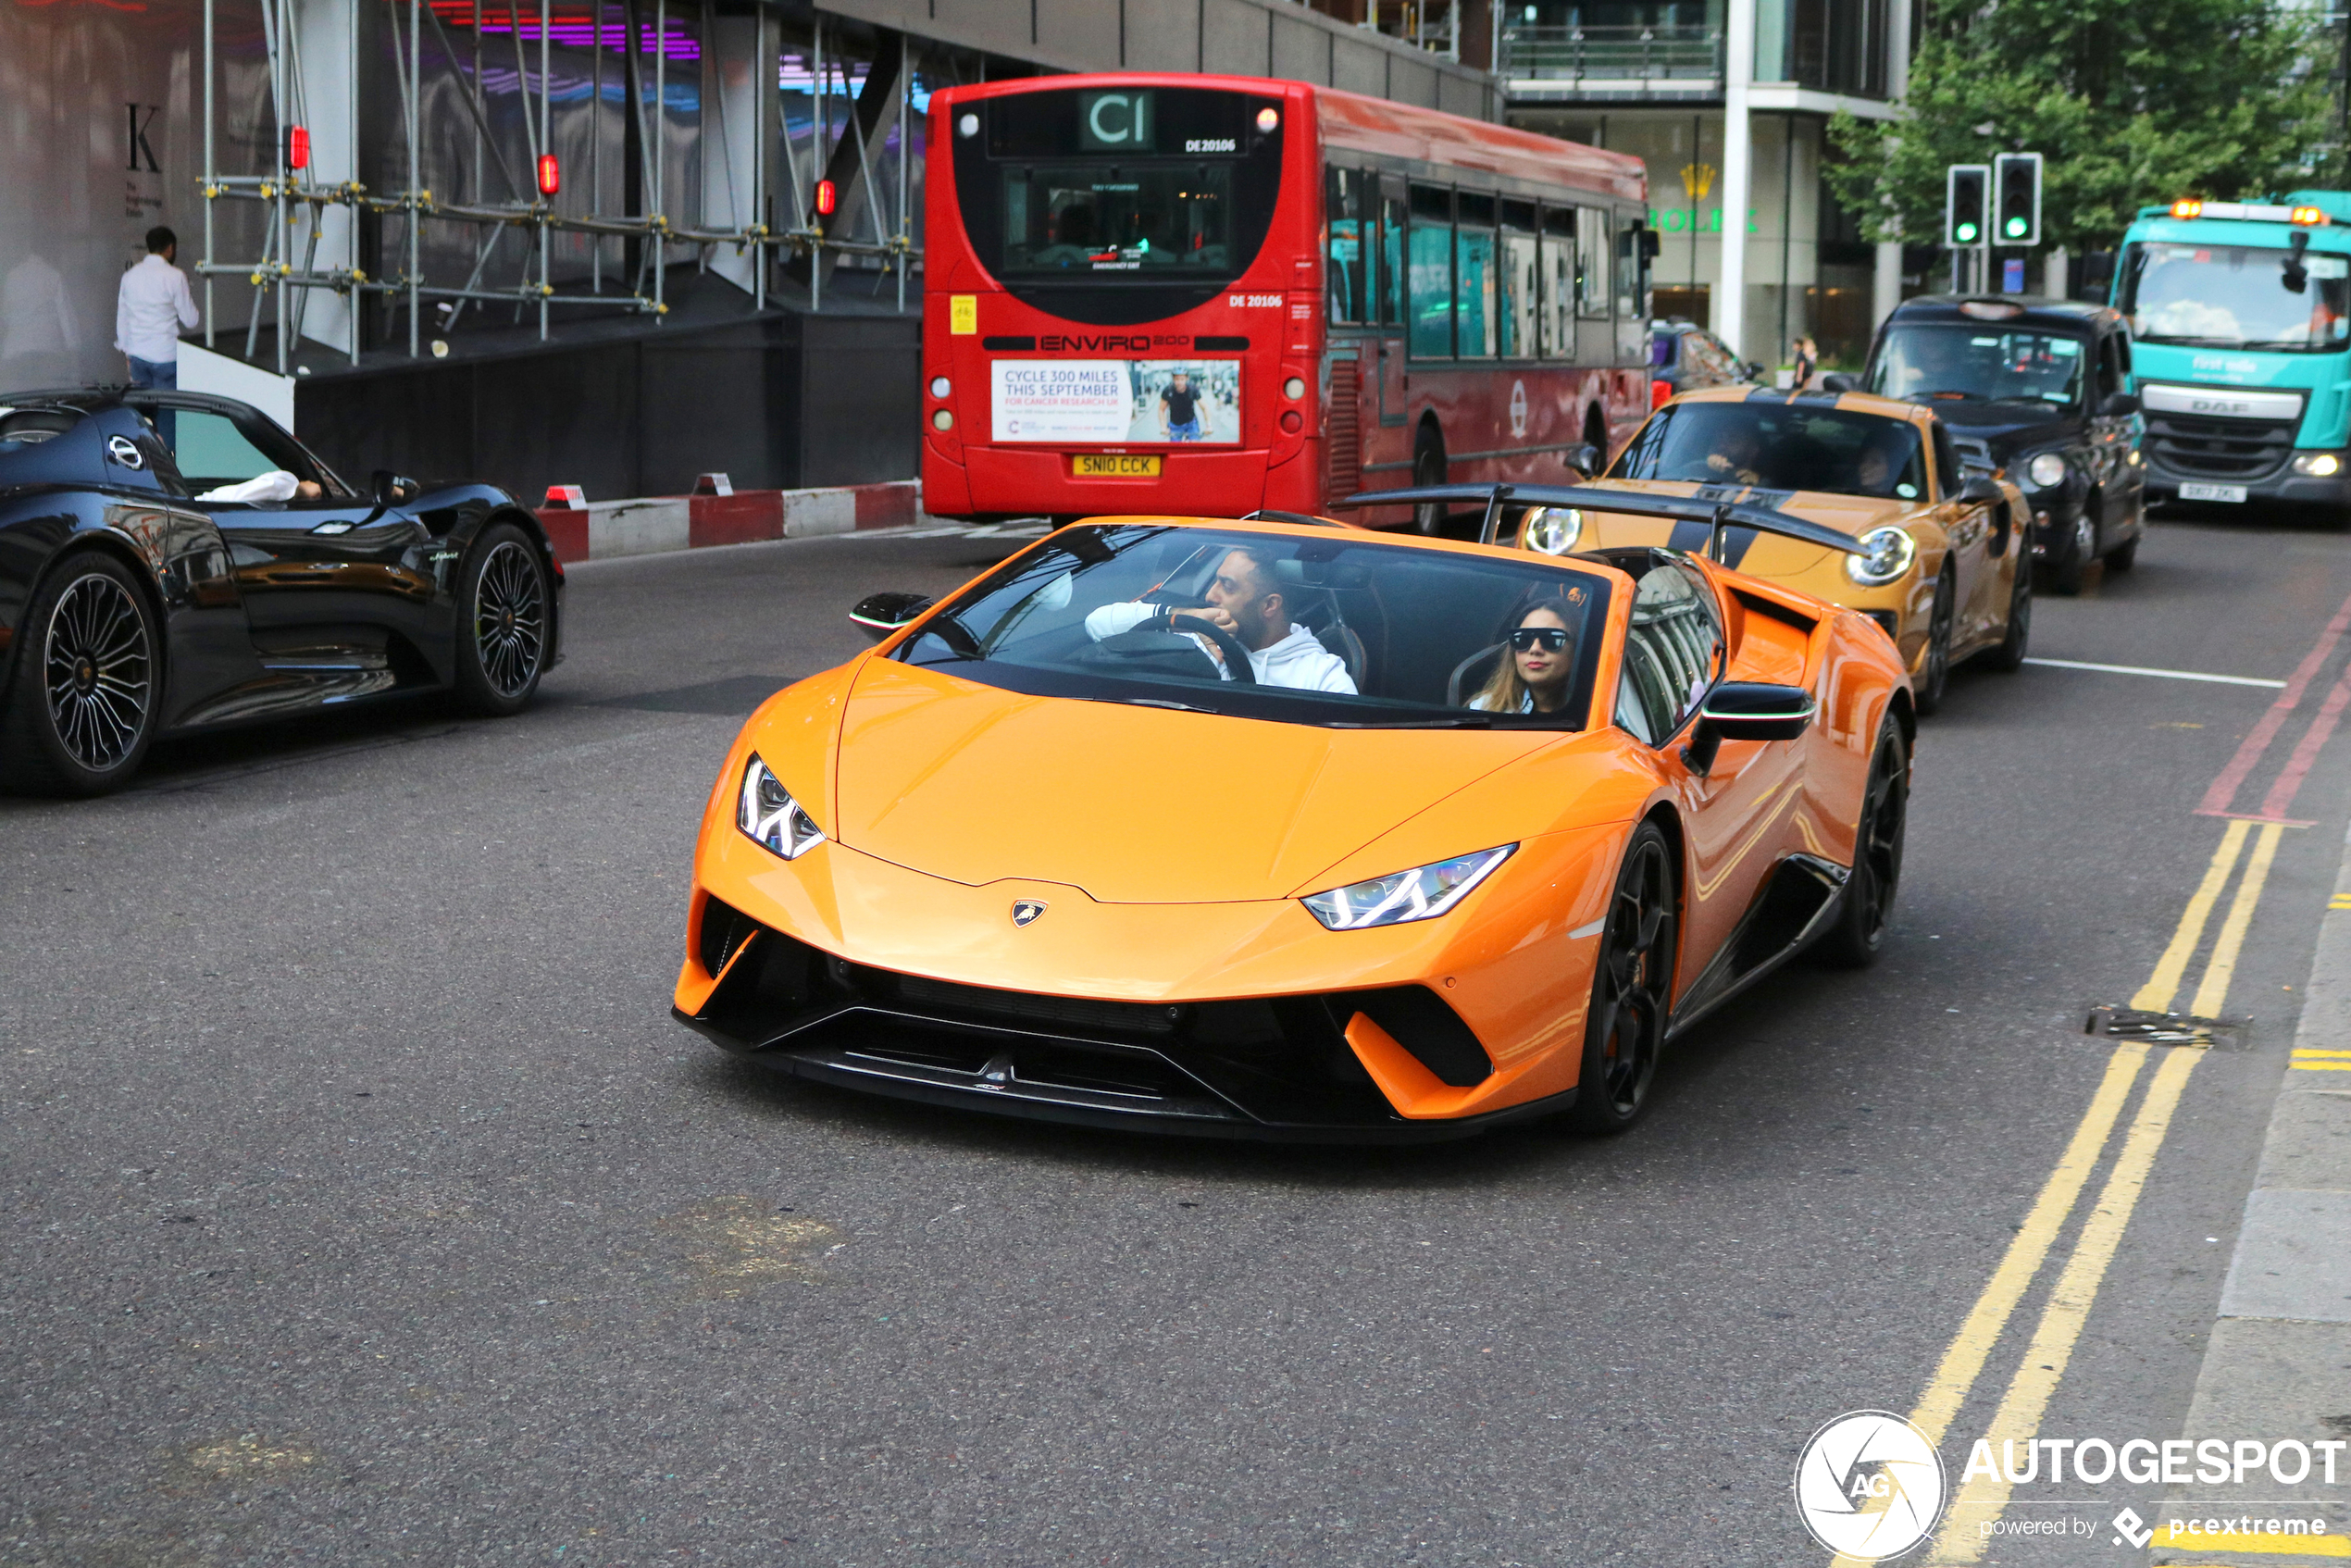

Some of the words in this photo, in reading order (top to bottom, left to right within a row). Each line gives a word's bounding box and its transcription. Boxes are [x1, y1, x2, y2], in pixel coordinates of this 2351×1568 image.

[1089, 94, 1144, 143] C1
[126, 103, 162, 173] K
[1229, 295, 1245, 307] DE
[1247, 295, 1282, 307] 20106
[1040, 335, 1151, 352] ENVIRO
[1153, 335, 1190, 345] 200
[1005, 370, 1047, 382] CYCLE
[1051, 370, 1076, 382] 300
[1079, 370, 1118, 382] MILES
[1005, 384, 1036, 396] THIS
[1040, 384, 1118, 396] SEPTEMBER
[1004, 397, 1022, 405] FOR
[1024, 397, 1059, 405] CANCER
[1061, 397, 1105, 405] RESEARCH
[1106, 397, 1118, 405] UK
[2192, 400, 2250, 413] DAF
[1083, 457, 1116, 473] SN10
[1121, 457, 1151, 473] CCK
